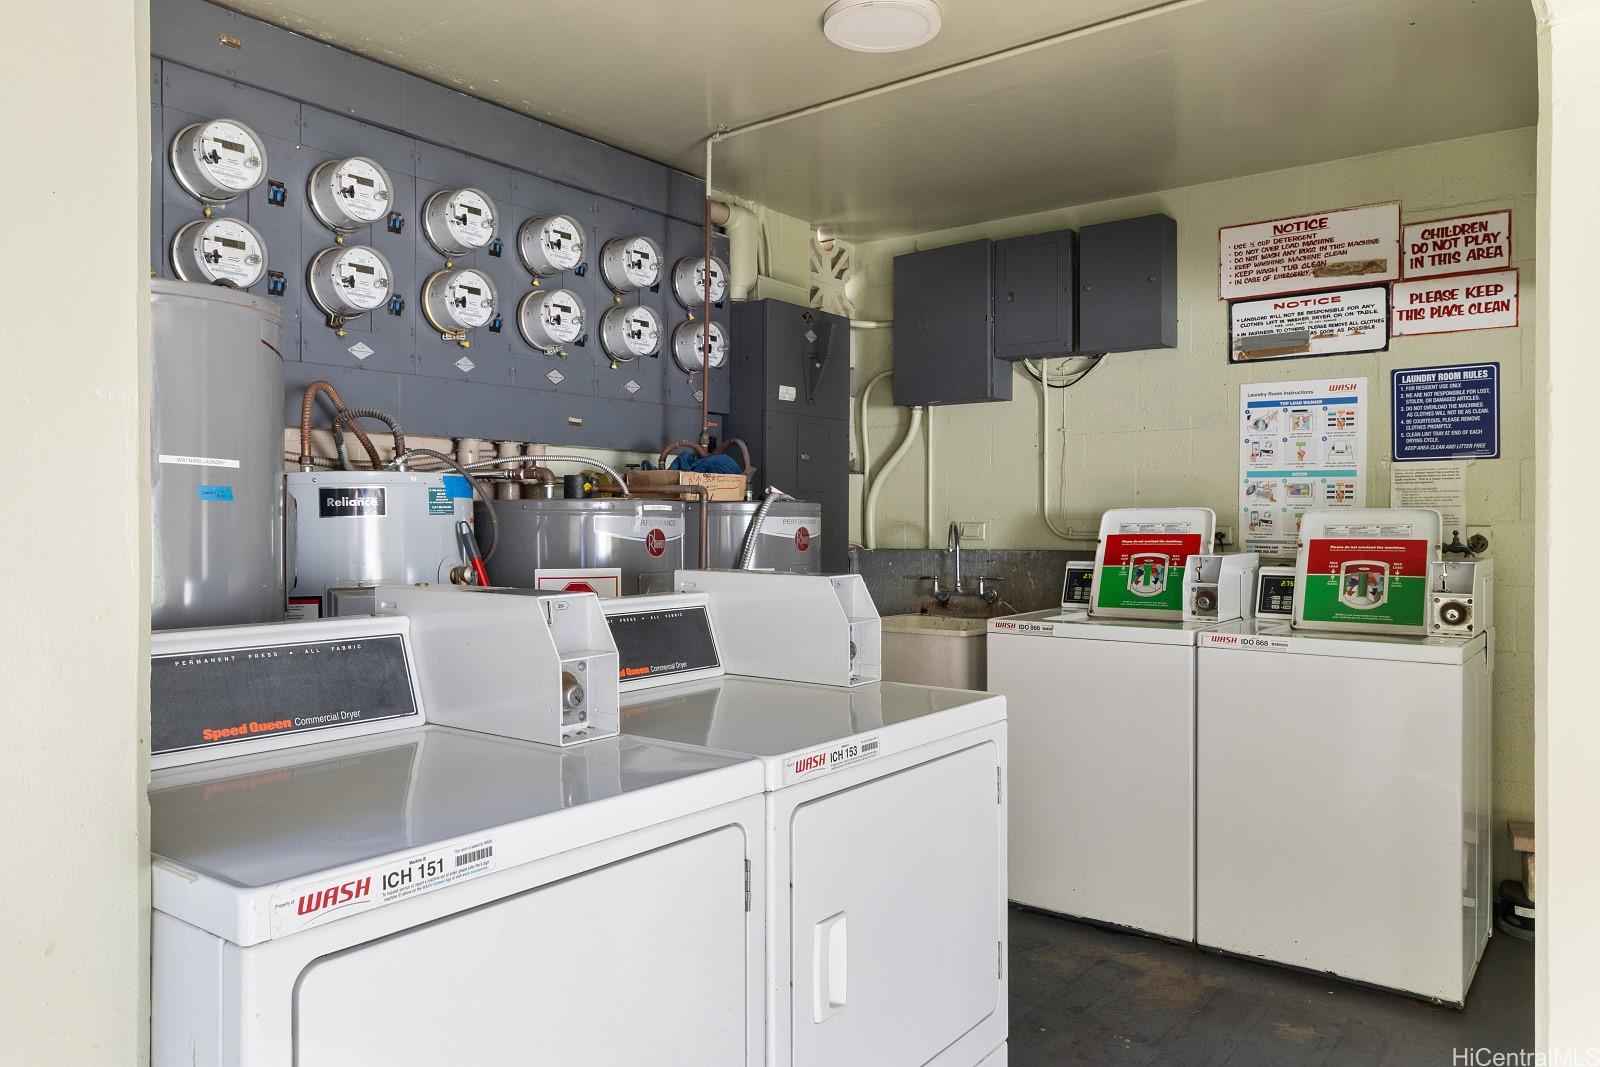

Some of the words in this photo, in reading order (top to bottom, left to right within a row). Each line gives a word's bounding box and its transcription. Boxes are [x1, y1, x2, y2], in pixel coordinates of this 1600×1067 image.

[1273, 217, 1329, 235] NOTICE
[1421, 221, 1488, 240] CHILDREN
[1246, 248, 1259, 256] NOT
[1261, 245, 1279, 253] OVER
[1302, 237, 1335, 247] MACHINE
[1258, 239, 1270, 247] CUP
[1274, 233, 1318, 244] DETERGENT
[1261, 252, 1280, 260] WASH
[1298, 247, 1316, 255] RUGS
[1330, 242, 1346, 250] THIS
[1347, 238, 1380, 248] MACHINE
[1411, 242, 1428, 254] DO
[1432, 237, 1461, 251] NOT
[1464, 232, 1501, 247] PLAY
[1234, 263, 1252, 271] KEEP
[1254, 258, 1285, 268] WASHING
[1288, 253, 1322, 263] MACHINE
[1324, 250, 1348, 258] CLEAN
[1410, 256, 1424, 270] IN
[1427, 251, 1462, 266] THIS
[1466, 245, 1504, 262] AREA
[1234, 270, 1254, 278] KEEP
[1256, 267, 1278, 275] WASH
[1282, 264, 1298, 272] TUB
[1302, 260, 1327, 270] CLEAN
[1244, 276, 1261, 284] CASE
[1262, 274, 1272, 282] OF
[1273, 296, 1341, 310] NOTICE
[1410, 288, 1460, 304] PLEASE
[1466, 284, 1504, 299] KEEP
[1306, 307, 1344, 315] RESPONSIBLE
[1397, 308, 1426, 321] THIS
[1430, 304, 1465, 319] PLACE
[1468, 299, 1510, 315] CLEAN
[1402, 374, 1436, 384] LAUNDRY
[1438, 372, 1461, 381] ROOM
[1463, 370, 1488, 379] RULES
[1328, 384, 1357, 392] WASH
[1434, 388, 1466, 396] RESPONSIBLE
[326, 496, 378, 508] Reliance
[1280, 580, 1294, 588] 2.75
[1210, 635, 1238, 644] WASH
[174, 655, 236, 667] PERMANENT
[248, 652, 278, 660] PRESS
[331, 644, 362, 652] FABRIC
[625, 666, 650, 676] Queen
[650, 662, 676, 673] Commercial
[676, 660, 687, 669] Dryer
[202, 724, 248, 742] Speed
[249, 718, 292, 734] Queen
[294, 712, 340, 727] Commercial
[340, 708, 362, 724] Dryer
[795, 752, 826, 774] WASH
[830, 750, 844, 763] ICH
[845, 745, 858, 758] 153
[297, 876, 372, 916] WASH
[382, 868, 412, 891] ICH
[417, 858, 444, 879] 151
